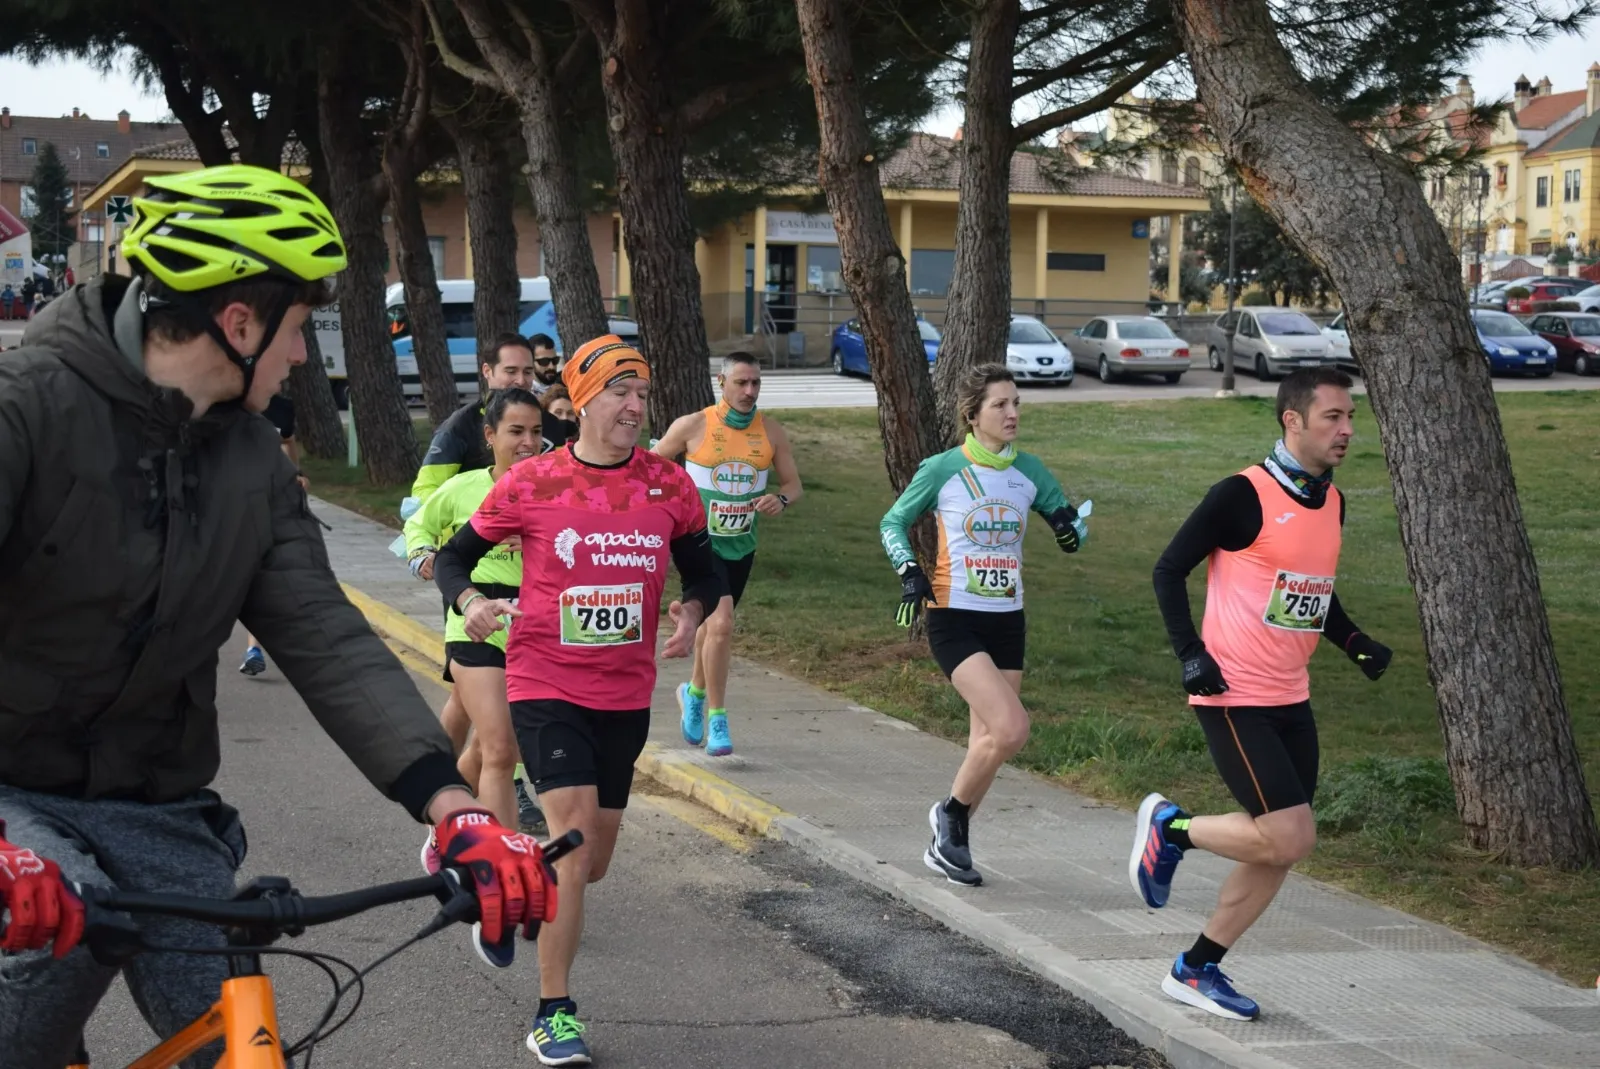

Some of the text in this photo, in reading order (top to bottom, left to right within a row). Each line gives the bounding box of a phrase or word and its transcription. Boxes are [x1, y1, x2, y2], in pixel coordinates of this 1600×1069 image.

[716, 473, 754, 485] ALCER
[718, 513, 748, 528] 777
[971, 521, 1021, 534] ALCER
[584, 529, 664, 552] apaches
[591, 551, 657, 573] running
[965, 555, 1018, 570] bedunia
[976, 569, 1009, 588] 735
[562, 588, 642, 607] bedunia
[1283, 592, 1321, 617] 750
[577, 606, 628, 631] 780
[456, 813, 491, 829] FOX
